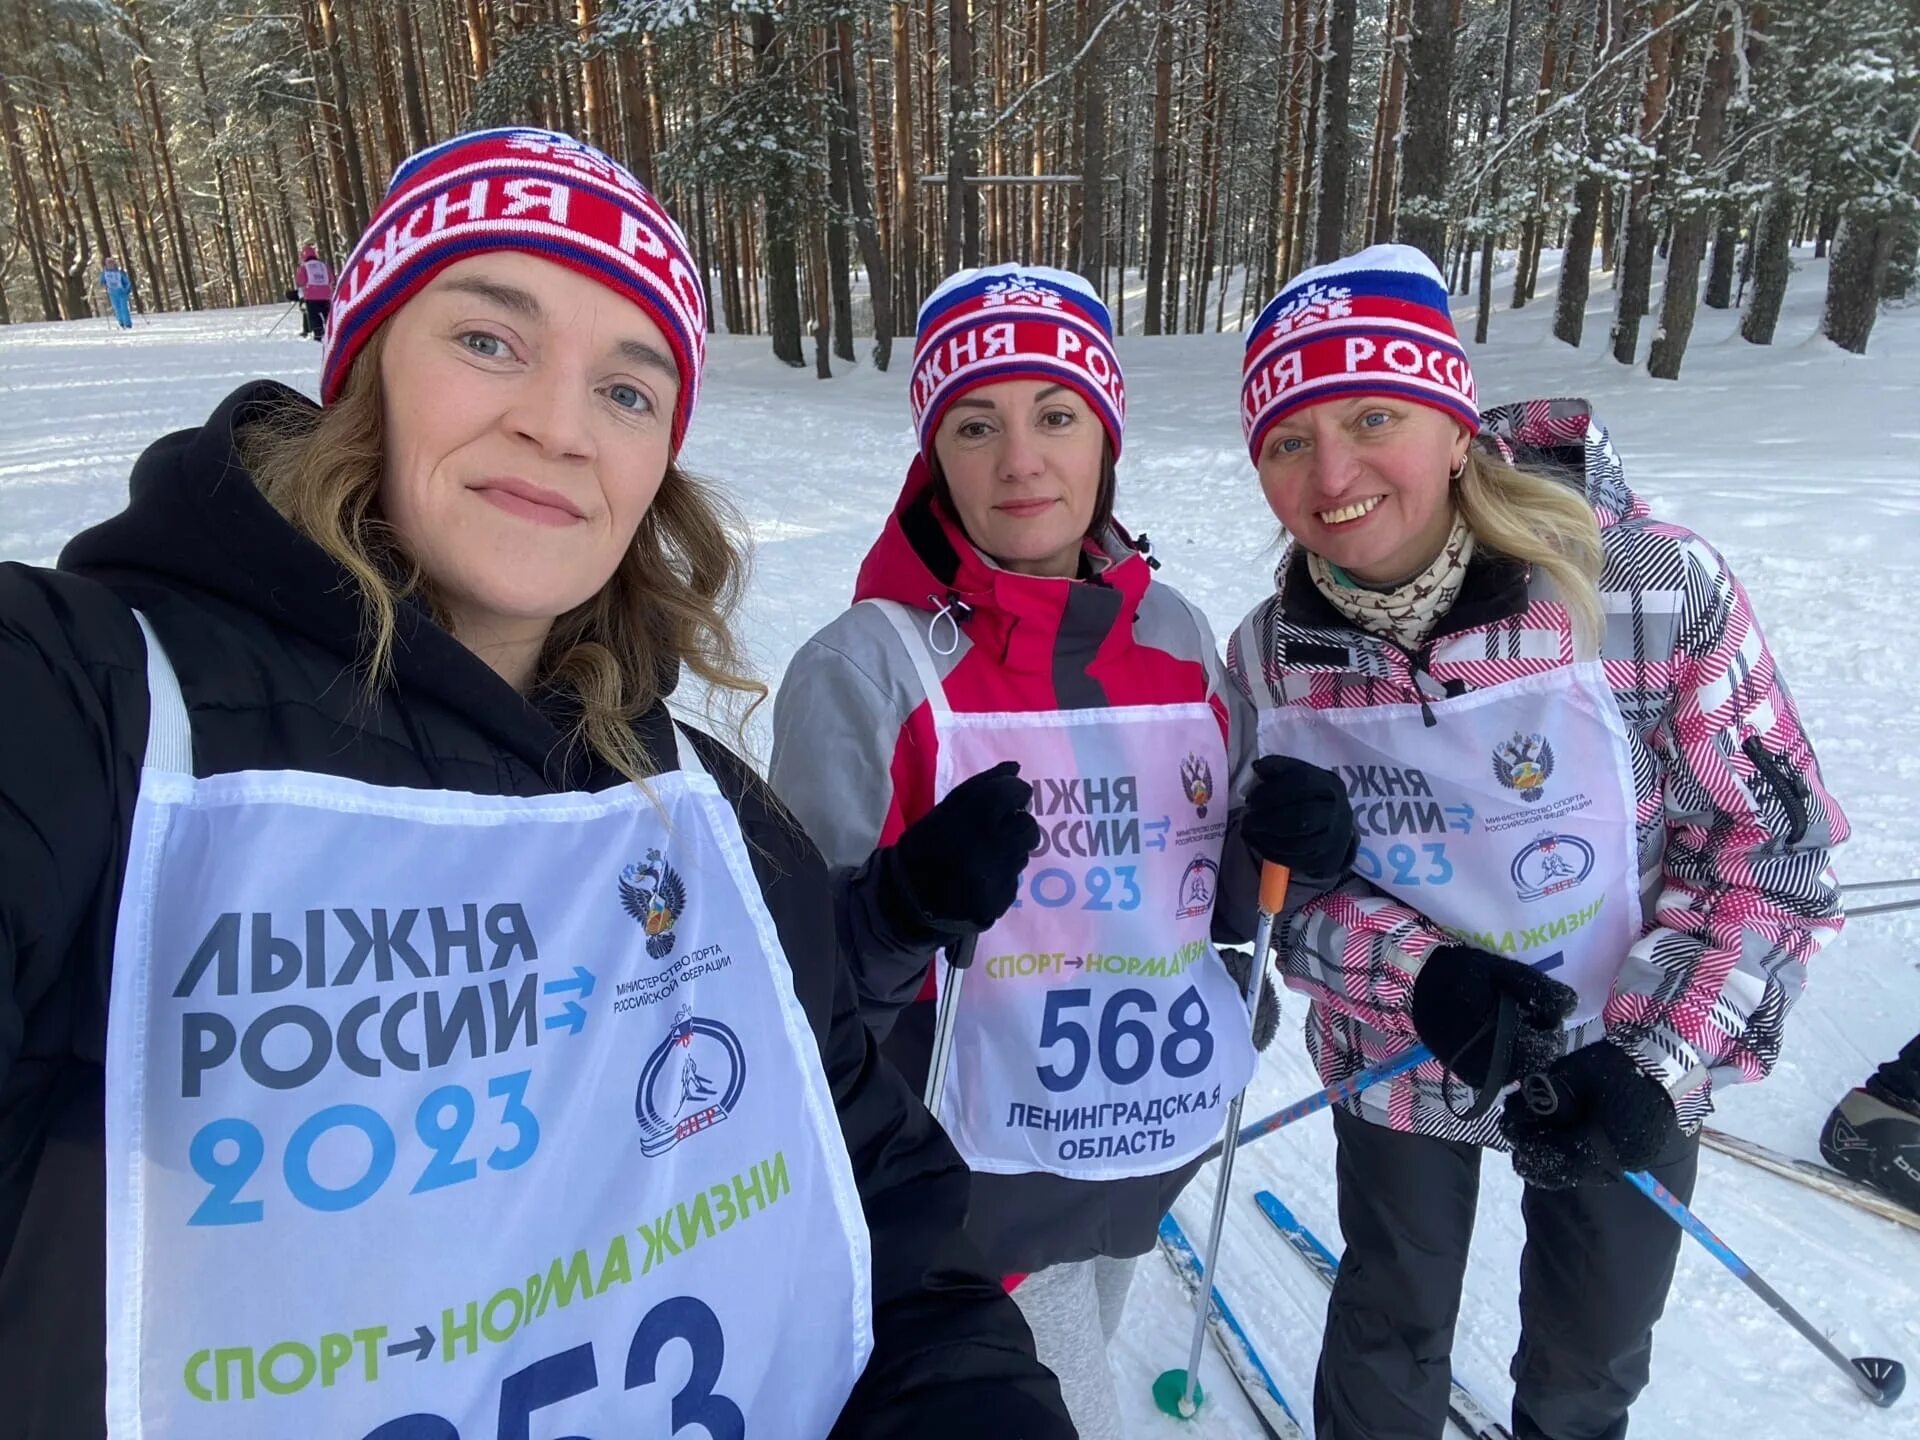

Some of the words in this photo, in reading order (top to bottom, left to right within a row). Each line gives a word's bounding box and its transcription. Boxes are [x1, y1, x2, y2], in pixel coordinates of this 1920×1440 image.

[1484, 804, 1553, 825] МИНИСТЕРСТВО
[1553, 793, 1586, 809] СПОРТА
[1484, 815, 1543, 833] РОССИЙСКОЙ
[1543, 799, 1593, 820] ФЕДЕРАЦИИ
[1012, 865, 1142, 911] 023
[171, 903, 539, 998] ЛЫЖНЯ
[616, 955, 691, 997] МИНИСТЕРСТВО
[691, 943, 723, 963] ПОРТА
[985, 952, 1066, 979] СПОРТ
[1085, 951, 1180, 978] НОРМА
[614, 979, 680, 1014] РОССИЙСКОЙ
[181, 973, 540, 1098] РОССИИ
[1036, 985, 1216, 1093] 568
[1006, 1083, 1222, 1132] ЛЕНИНГРАДСКАЯ
[185, 1069, 541, 1227] 2023
[1058, 1128, 1176, 1160] ОБЛАСТЬ
[183, 1325, 388, 1403] СПОРТ
[442, 1236, 632, 1363] НОРМА
[640, 1151, 792, 1275] ЖИЗНИ
[361, 1296, 746, 1440] 53
